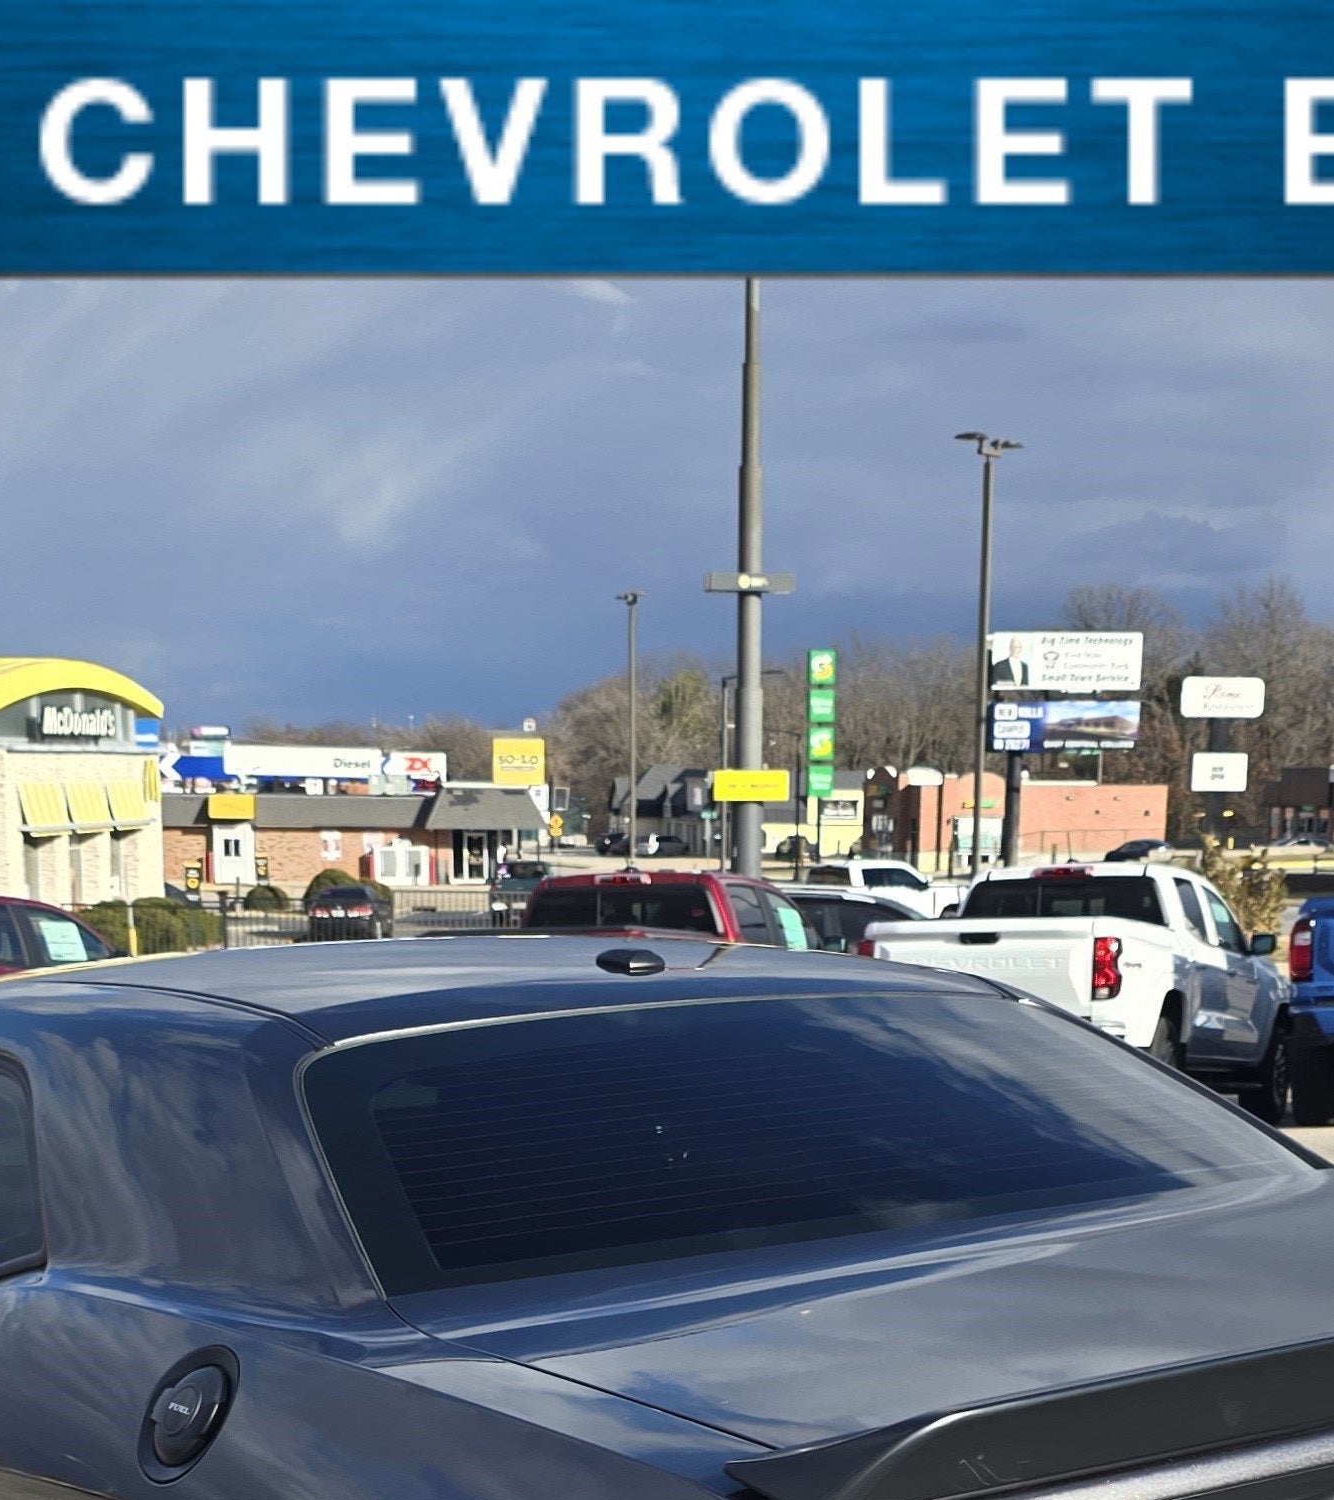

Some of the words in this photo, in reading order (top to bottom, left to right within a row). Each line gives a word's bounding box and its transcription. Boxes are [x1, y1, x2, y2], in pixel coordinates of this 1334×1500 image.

[42, 706, 116, 737] McDonald's
[333, 757, 371, 769] Diesel
[168, 1402, 191, 1415] FUEL
